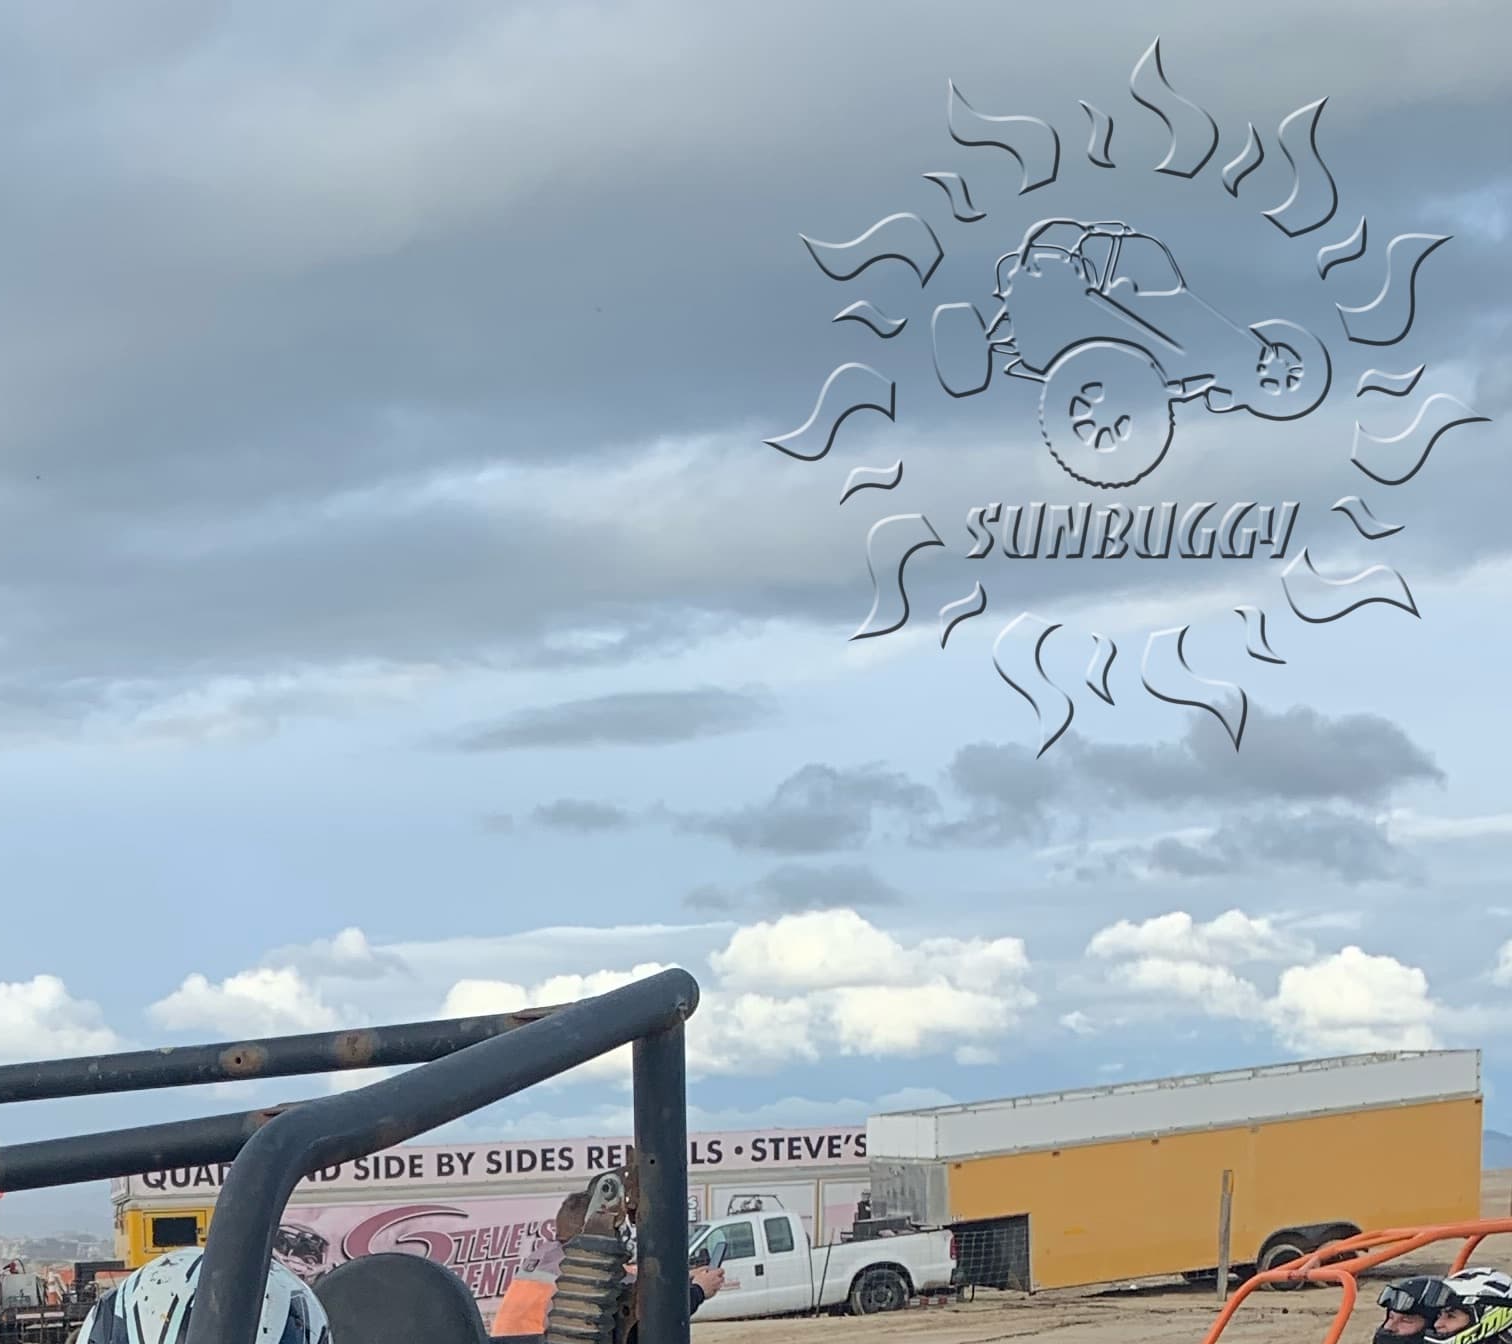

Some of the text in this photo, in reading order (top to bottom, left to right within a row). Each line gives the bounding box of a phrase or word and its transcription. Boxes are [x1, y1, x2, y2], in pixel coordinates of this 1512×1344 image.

[353, 1154, 424, 1181] SIDE
[436, 1151, 476, 1178] BY
[486, 1146, 575, 1175] SIDES
[750, 1133, 867, 1162] STEVE'S
